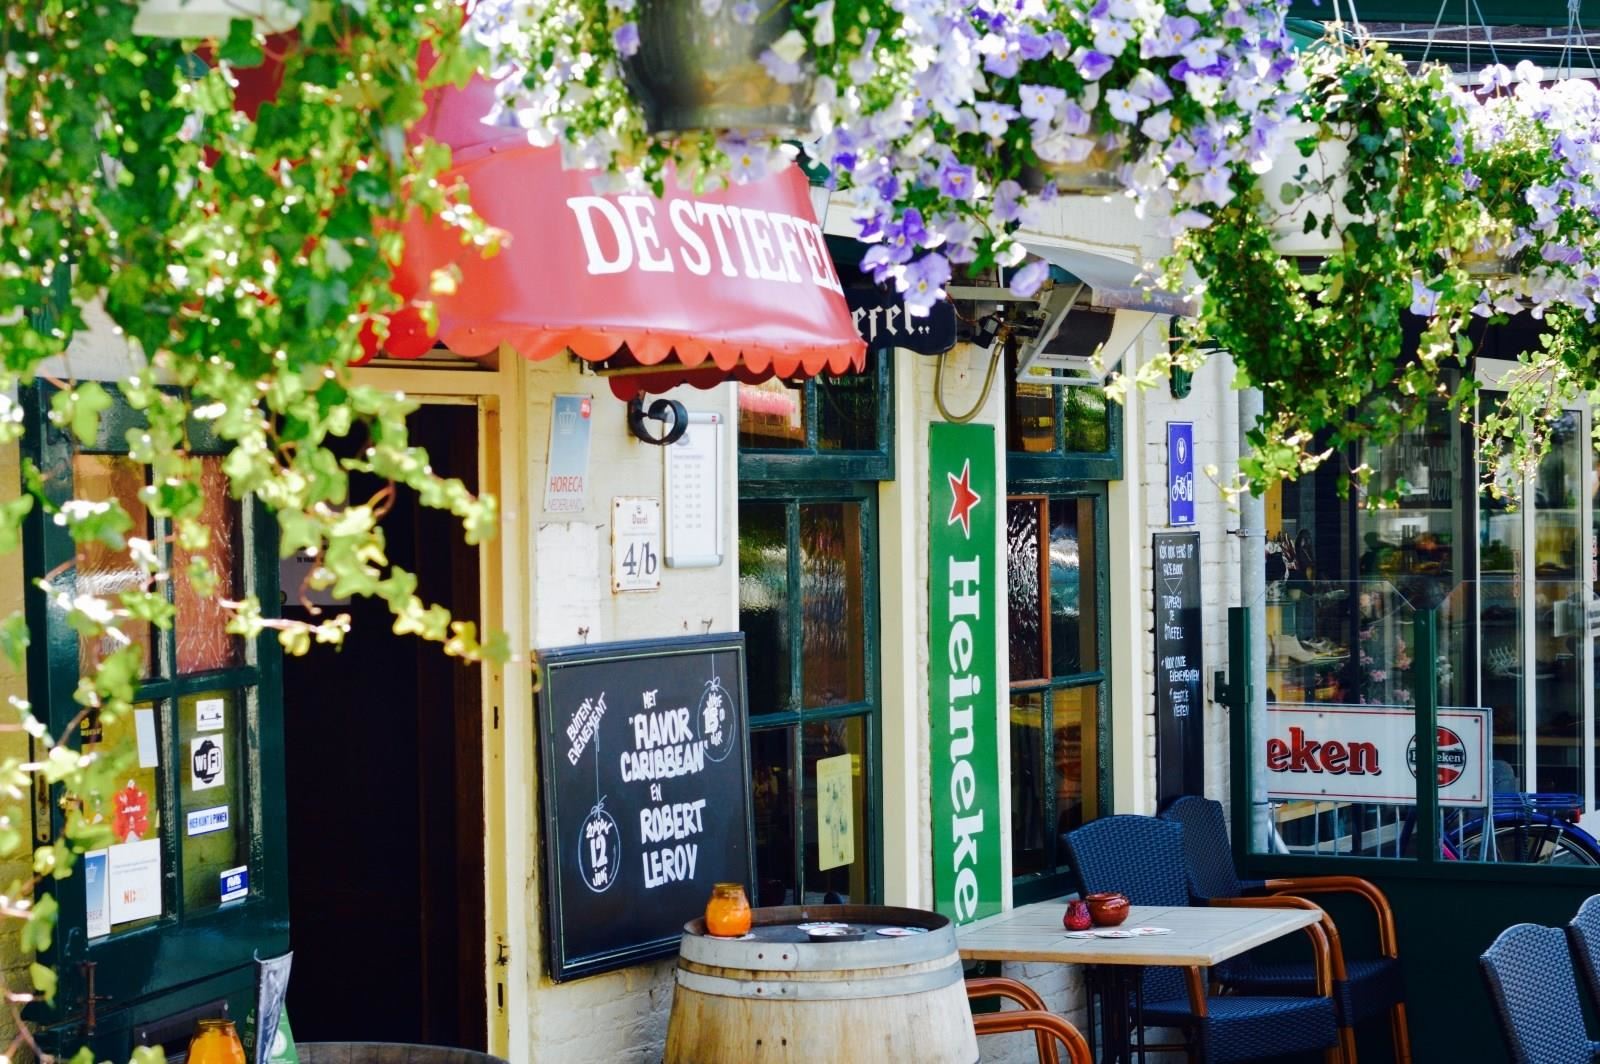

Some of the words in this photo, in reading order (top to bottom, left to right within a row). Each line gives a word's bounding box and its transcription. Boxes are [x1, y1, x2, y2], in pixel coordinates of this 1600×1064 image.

[566, 195, 674, 275] DE
[669, 198, 845, 297] STIEFEL
[550, 475, 583, 493] HORECA
[622, 541, 657, 577] 4/b
[643, 689, 658, 709] MET
[567, 692, 607, 766] EVENEMENT
[948, 555, 984, 925] Heineke
[650, 783, 662, 802] EN
[640, 799, 706, 844] ROBERT
[590, 834, 608, 868] 12
[642, 843, 698, 889] LEROY
